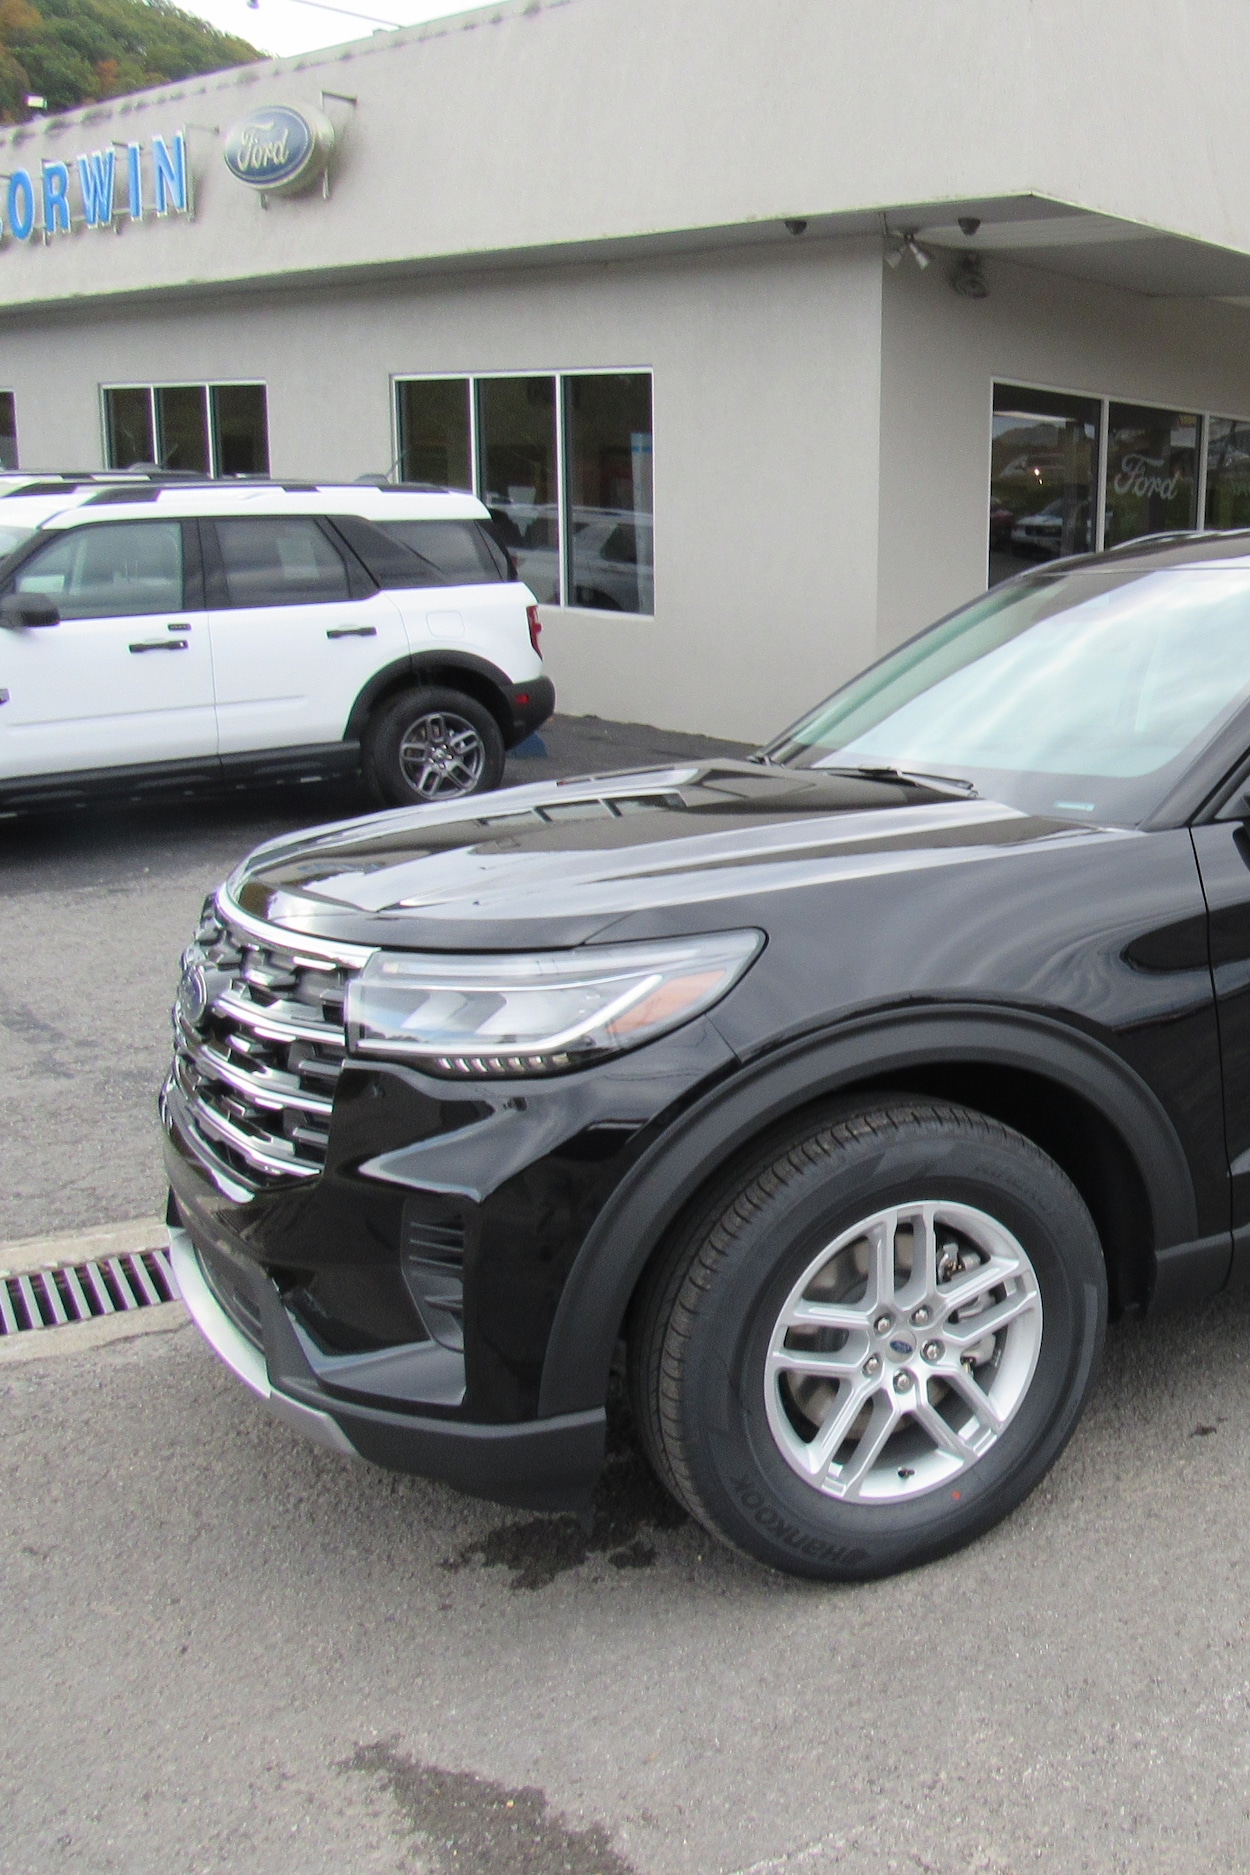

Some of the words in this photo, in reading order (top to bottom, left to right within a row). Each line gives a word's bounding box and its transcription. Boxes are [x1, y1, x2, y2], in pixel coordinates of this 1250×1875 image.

[237, 120, 290, 172] Ford
[0, 129, 188, 241] ORWIN
[1113, 453, 1182, 501] Ford
